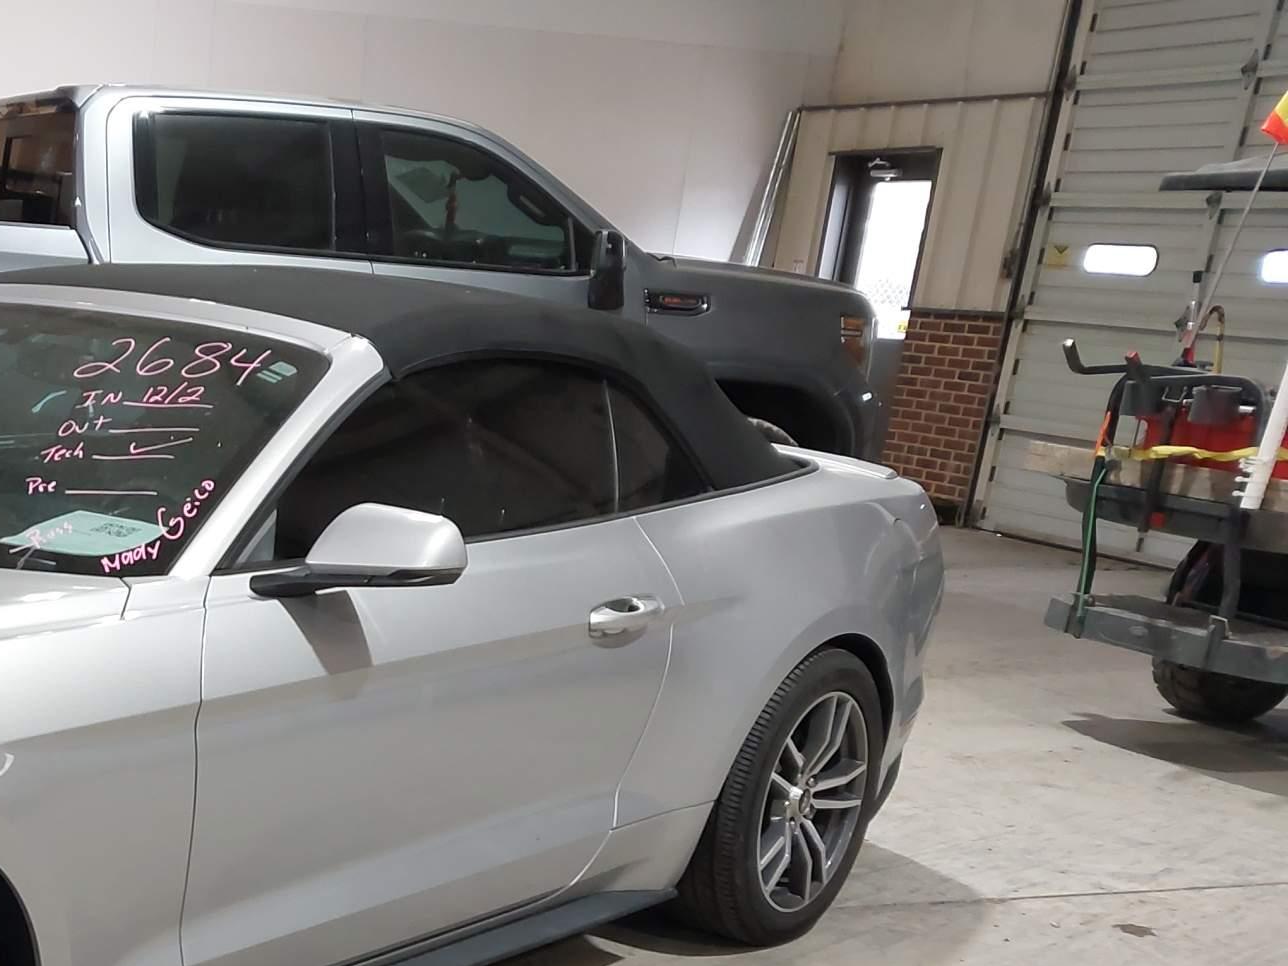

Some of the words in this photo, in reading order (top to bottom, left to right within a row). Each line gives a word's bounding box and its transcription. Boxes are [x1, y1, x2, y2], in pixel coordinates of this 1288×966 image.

[73, 337, 271, 386] 2684
[141, 382, 205, 405] 12/2
[40, 442, 84, 463] Tech
